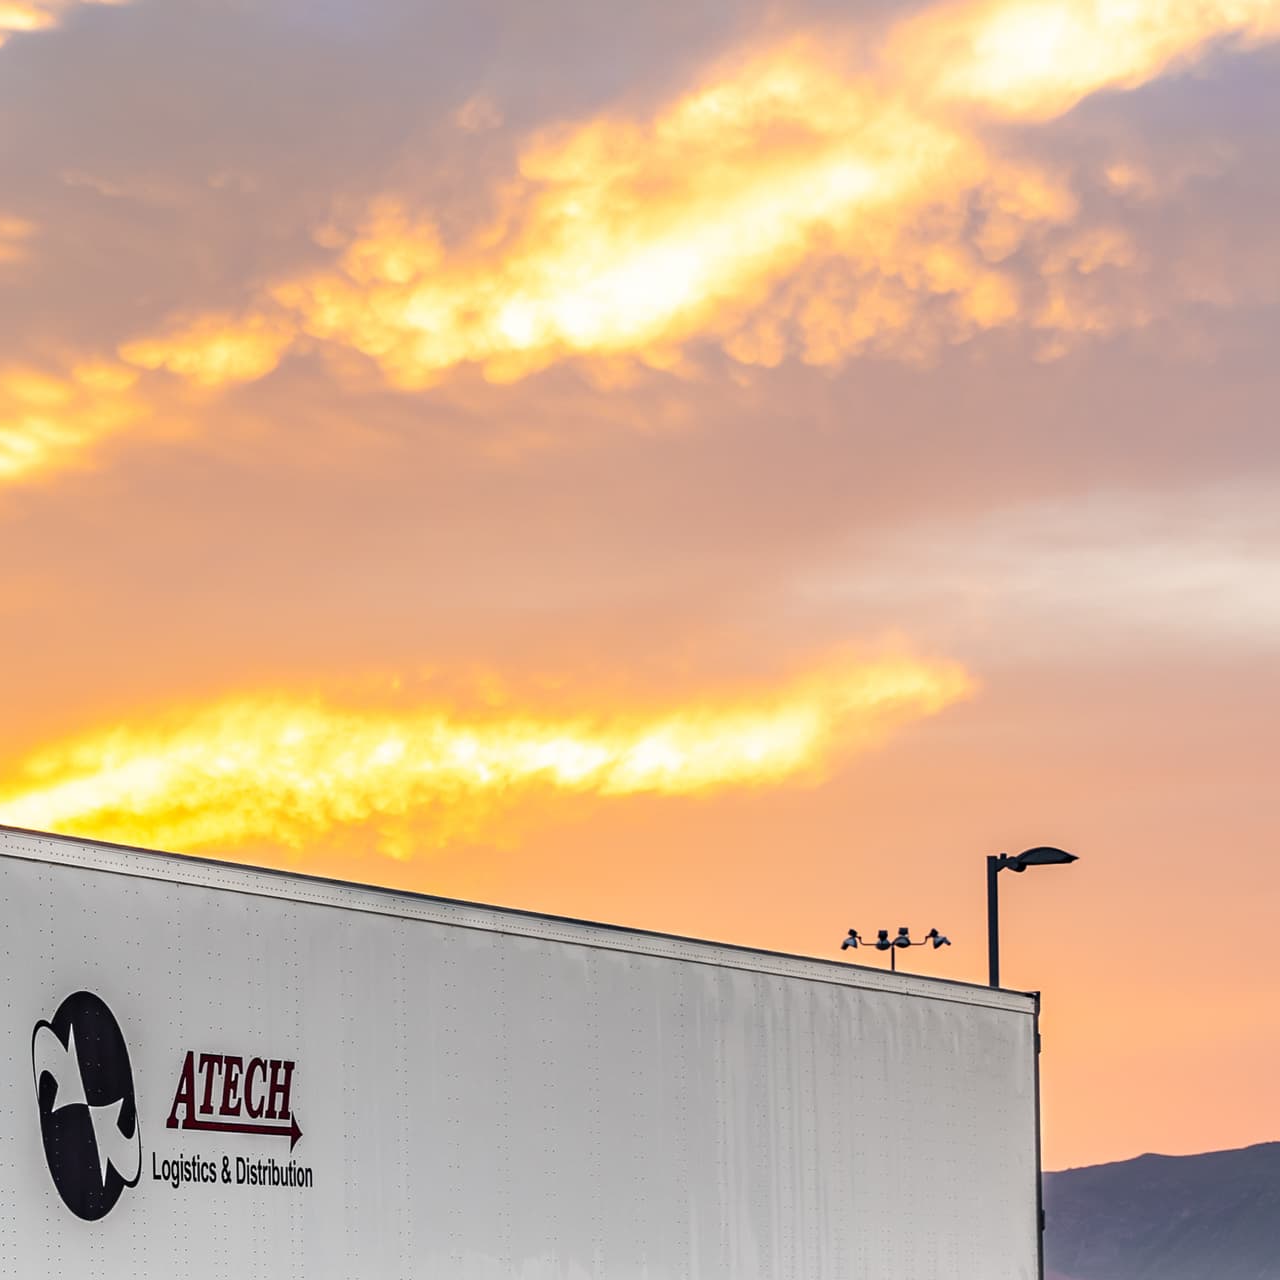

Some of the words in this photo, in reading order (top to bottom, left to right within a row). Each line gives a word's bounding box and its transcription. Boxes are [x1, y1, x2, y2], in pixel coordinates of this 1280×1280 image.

[166, 1050, 296, 1130] ATECH
[152, 1151, 217, 1189] Logistics
[221, 1155, 232, 1185] &
[236, 1156, 313, 1188] Distribution
